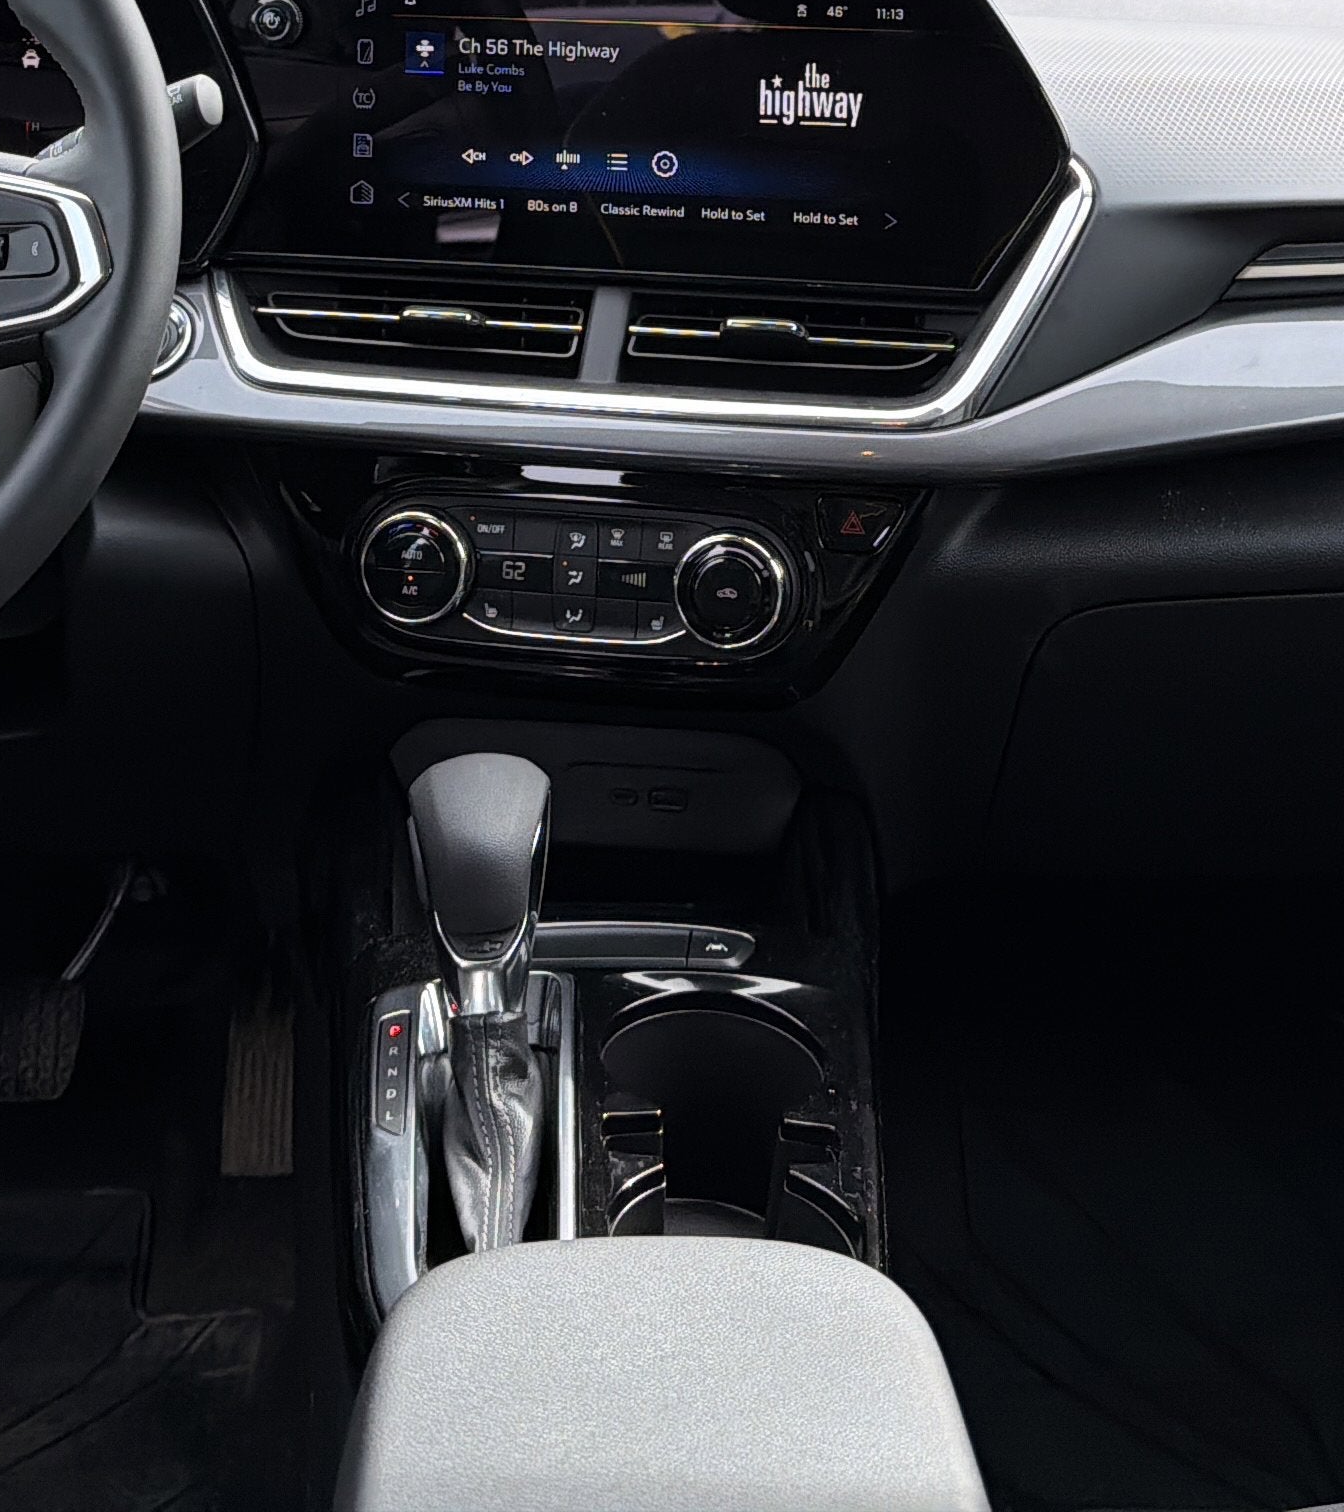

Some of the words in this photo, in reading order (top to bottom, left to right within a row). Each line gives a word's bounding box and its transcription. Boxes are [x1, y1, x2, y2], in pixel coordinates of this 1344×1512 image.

[876, 7, 905, 21] 11:13
[458, 37, 481, 55] Ch
[485, 38, 509, 56] 56
[512, 39, 544, 57] The
[548, 40, 620, 63] Highway
[458, 63, 484, 75] Luke
[486, 63, 525, 77] Combs
[804, 62, 831, 89] the
[457, 80, 473, 92] Be
[475, 81, 490, 95] By
[491, 81, 513, 94] You
[759, 78, 864, 128] highway
[31, 121, 41, 132] H
[473, 151, 487, 162] CH
[509, 152, 523, 163] CH
[422, 195, 472, 208] SiriusXM
[474, 197, 497, 210] Hits
[552, 203, 567, 213] on
[600, 203, 641, 217] Classic
[642, 205, 685, 218] Rewind
[701, 207, 729, 220] Hold
[731, 209, 744, 221] to
[746, 209, 766, 222] Set
[793, 211, 821, 224] Hold
[823, 213, 837, 225] to
[838, 213, 859, 226] Set
[476, 523, 505, 535] ON/OFF
[610, 539, 624, 548] MAX
[400, 549, 423, 561] AUTO
[501, 560, 526, 581] 62
[401, 585, 418, 597] A/C
[388, 1046, 399, 1057] R
[387, 1066, 398, 1078] N
[385, 1088, 397, 1100] D
[385, 1110, 394, 1121] L
